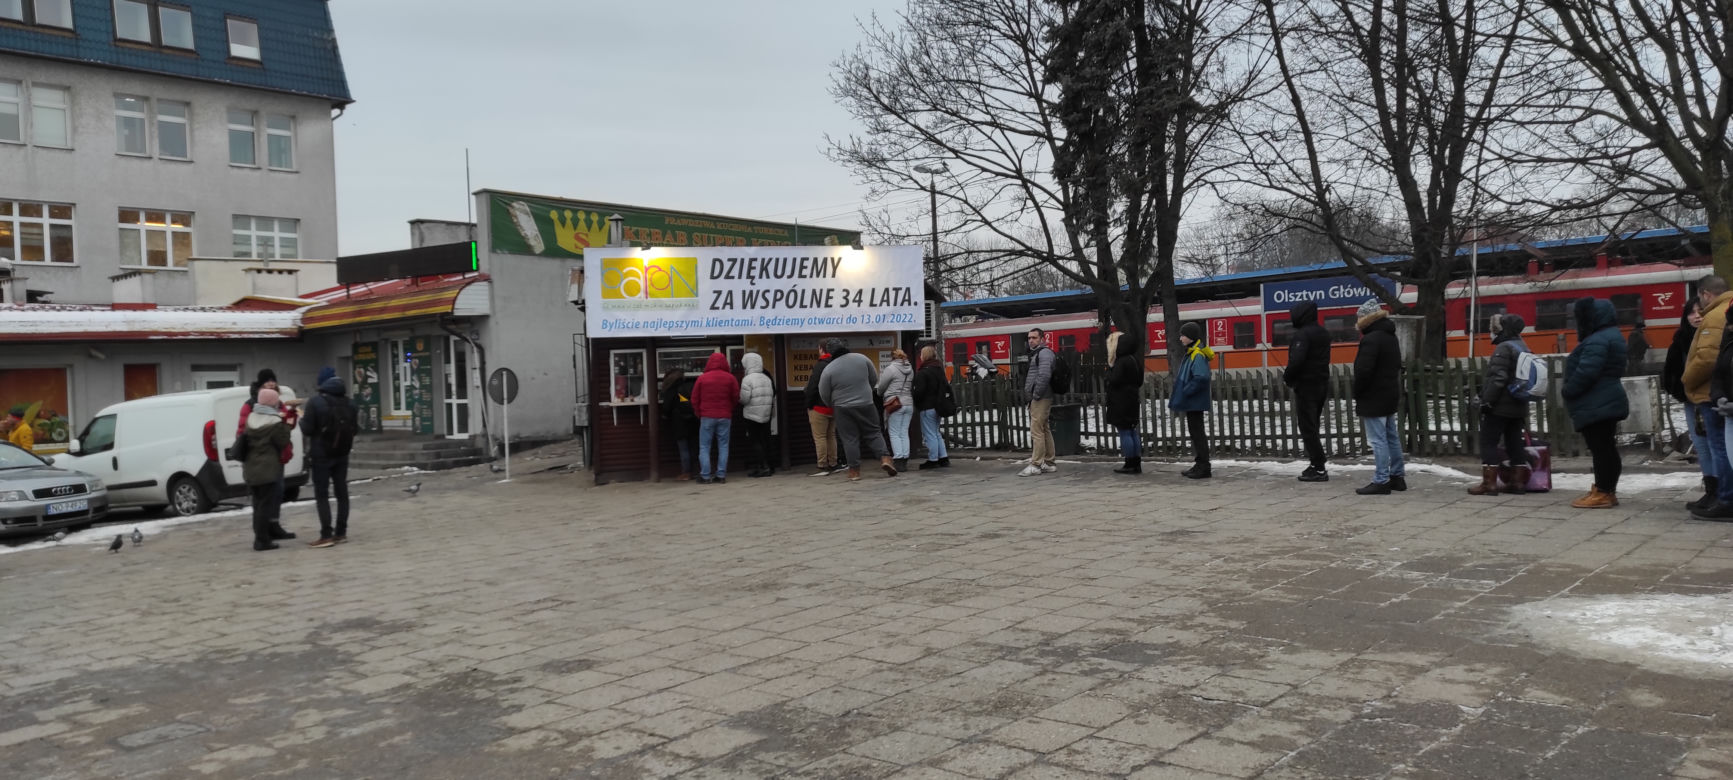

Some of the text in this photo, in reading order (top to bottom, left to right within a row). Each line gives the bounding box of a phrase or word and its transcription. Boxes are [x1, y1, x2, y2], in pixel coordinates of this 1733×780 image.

[574, 232, 590, 250] S
[623, 225, 688, 246] KEBAB
[692, 232, 746, 247] SUPER
[709, 256, 842, 285] DZIĘKUJEMY
[709, 284, 918, 311] ZA WSPÓLNE 34 LATA.
[1273, 284, 1379, 303] Olsztyn Główn
[601, 313, 917, 332] Byliście najlepszymi klientami. Będziemy otwarci do 13.01.2022.
[1217, 320, 1223, 331] 2
[794, 364, 813, 372] KEBA
